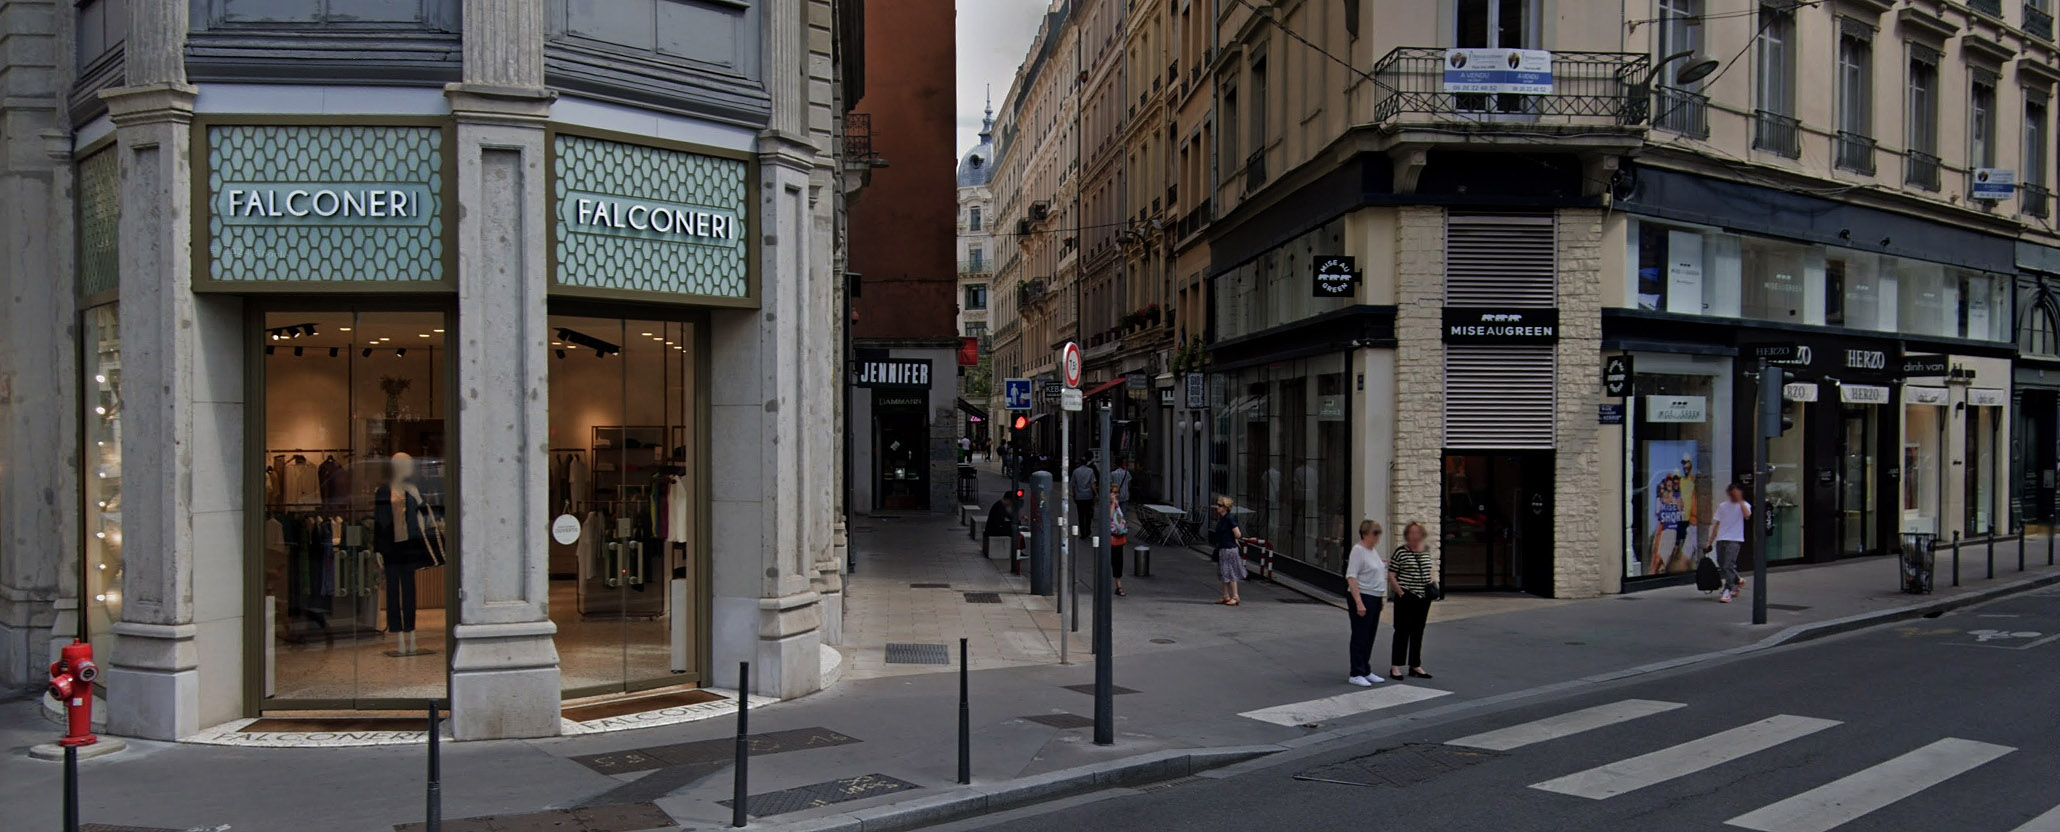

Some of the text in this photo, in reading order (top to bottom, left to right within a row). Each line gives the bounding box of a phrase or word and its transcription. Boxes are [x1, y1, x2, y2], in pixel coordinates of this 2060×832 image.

[228, 189, 419, 218] FALCONERI
[577, 198, 733, 240] FALCONERI
[1319, 259, 1350, 273] MISE AU
[1321, 282, 1348, 293] GREEN
[1755, 346, 1790, 356] HERZO
[1847, 349, 1886, 370] HERZO
[1903, 361, 1945, 372] dinh van
[860, 362, 929, 384] JENNIFER
[1787, 385, 1806, 399] RZO
[1851, 387, 1880, 401] HERZO
